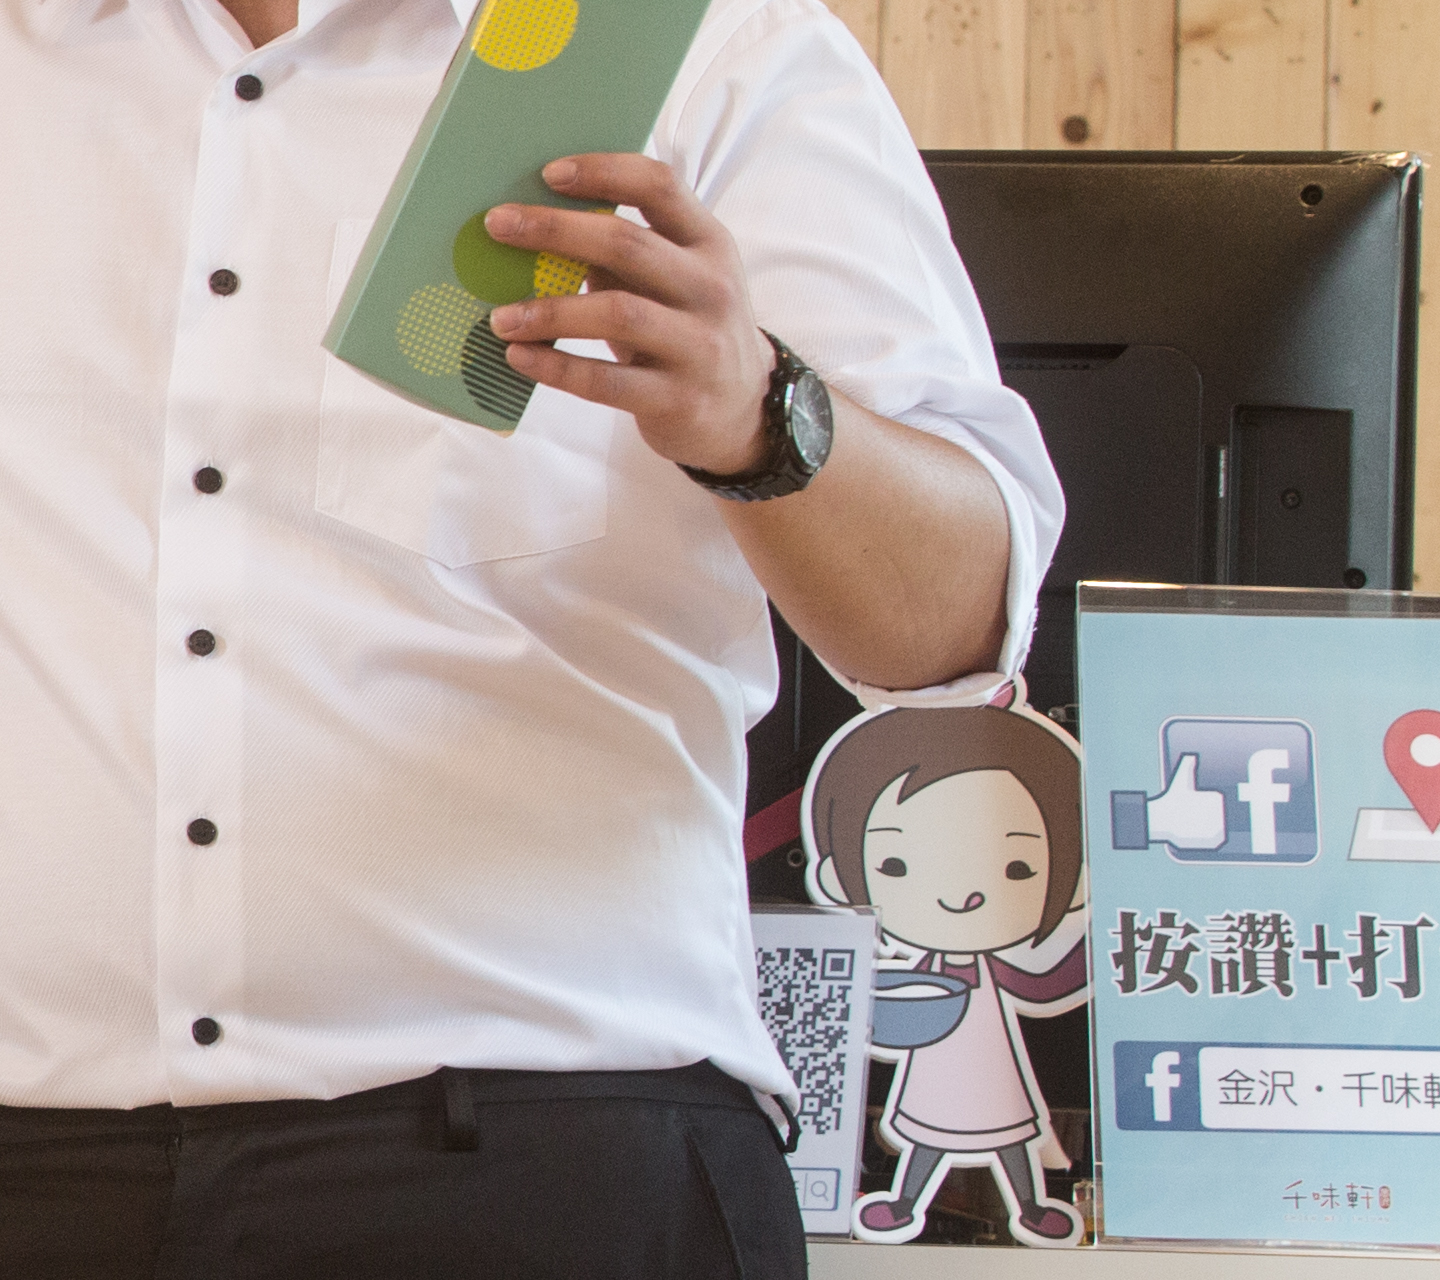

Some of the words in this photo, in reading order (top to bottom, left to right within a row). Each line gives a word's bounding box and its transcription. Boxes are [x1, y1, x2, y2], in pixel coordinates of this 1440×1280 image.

[1111, 911, 1435, 999] 按讚+打
[1282, 1180, 1374, 1210] 千味軒
